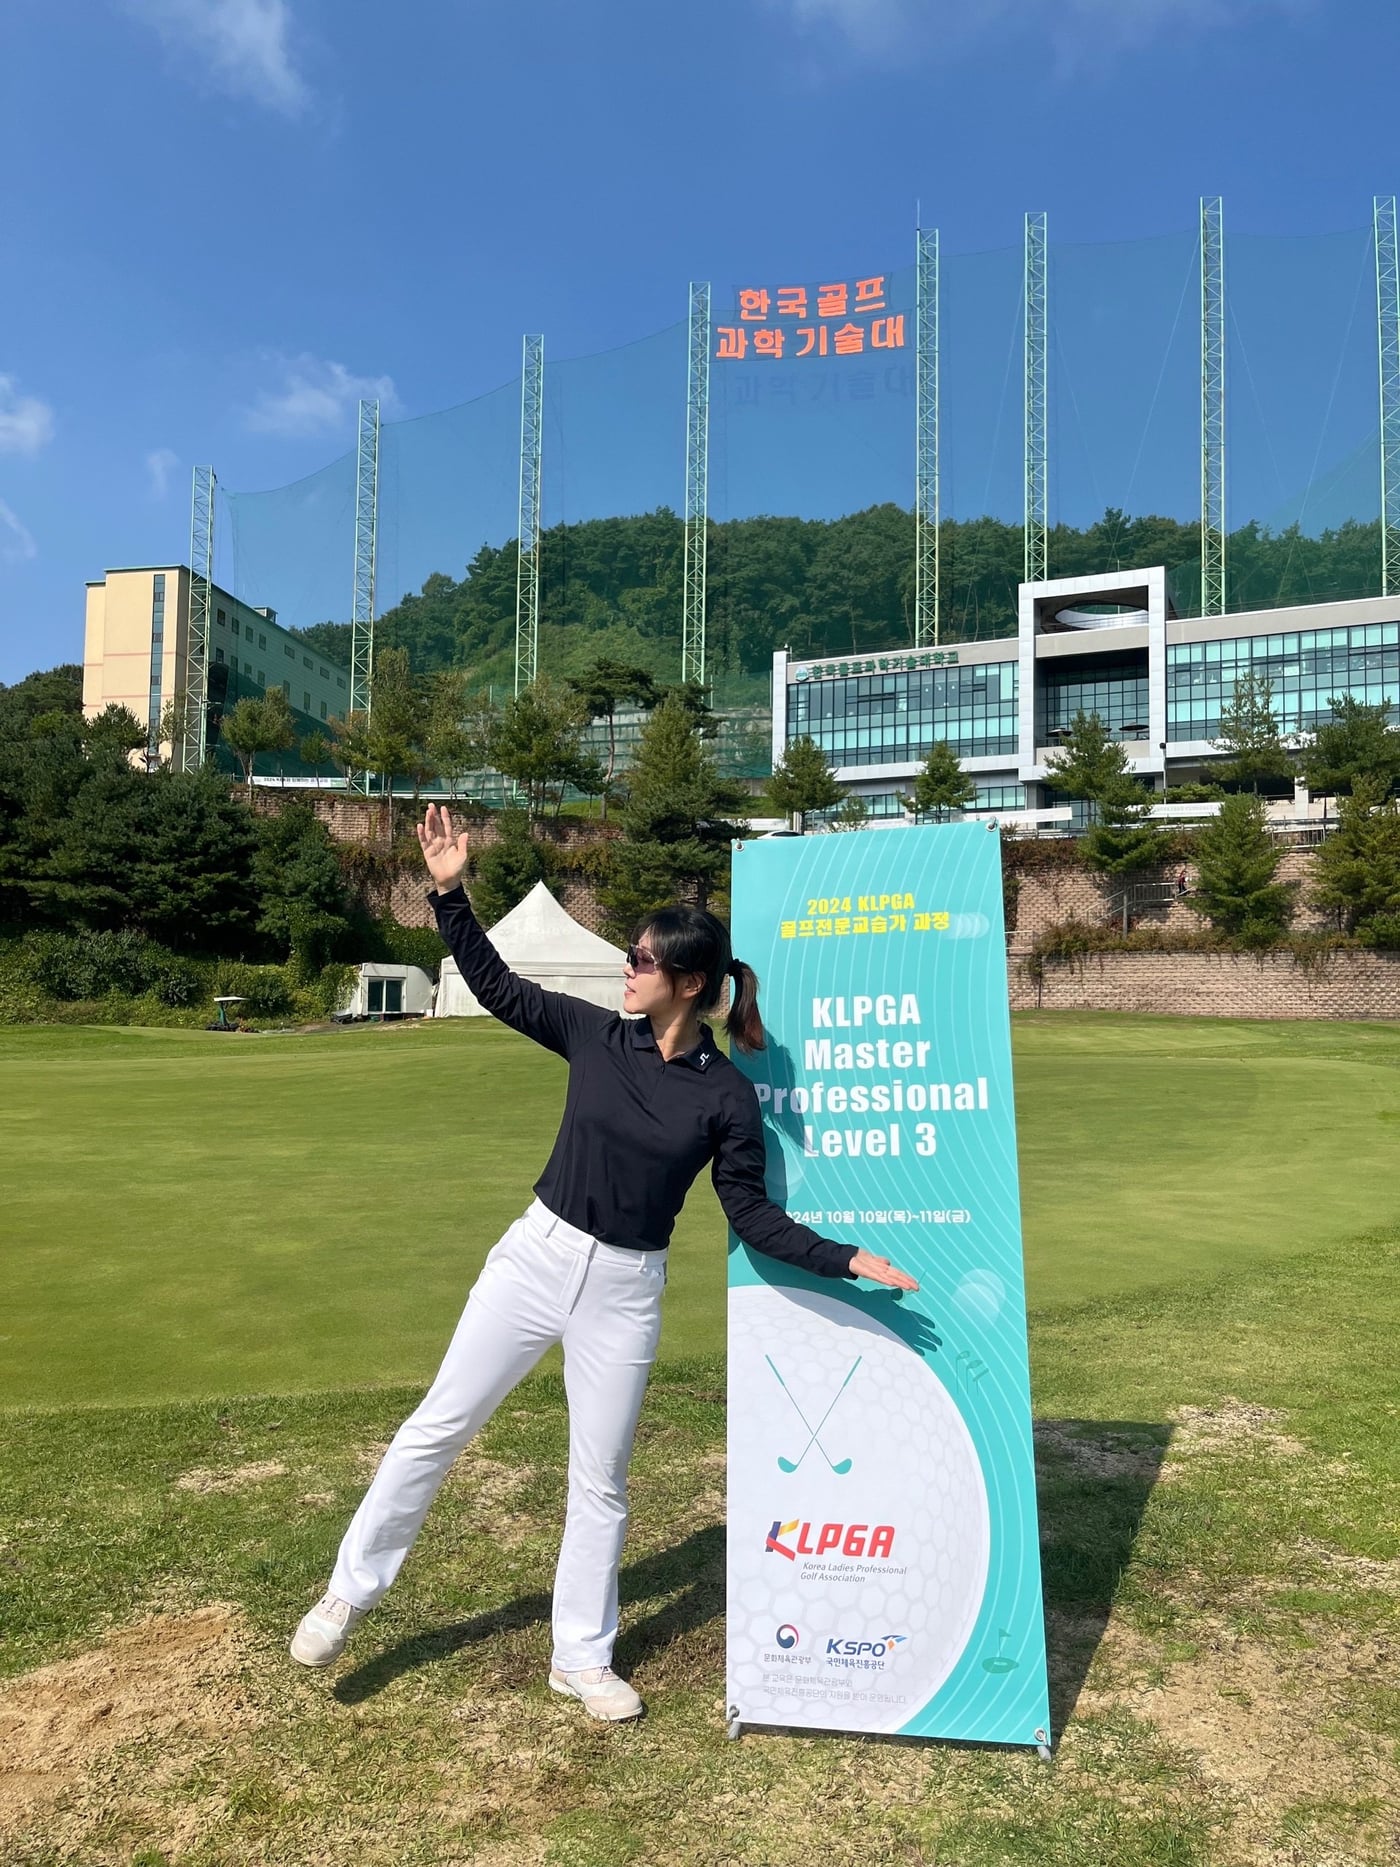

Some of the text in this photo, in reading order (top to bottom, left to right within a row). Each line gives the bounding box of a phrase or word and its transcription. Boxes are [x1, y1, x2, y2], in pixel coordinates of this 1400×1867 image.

[739, 276, 885, 320] 한국골프
[807, 893, 915, 916] 2024 KLPGA
[781, 911, 949, 939] 골프전문교습가 과정
[812, 994, 921, 1028] KLPGA
[804, 1039, 931, 1070] Master
[754, 1077, 989, 1114] Professional
[804, 1122, 937, 1158] Level 3
[827, 1210, 855, 1224] 10월
[765, 1518, 895, 1561] KLPGA
[800, 1572, 866, 1583] Golf Association
[803, 1562, 907, 1575] Korea Ladies Professional
[764, 1653, 812, 1665] 문화체육관광부
[826, 1638, 886, 1658] KSPO
[826, 1657, 885, 1671] 국민체육진흥공단
